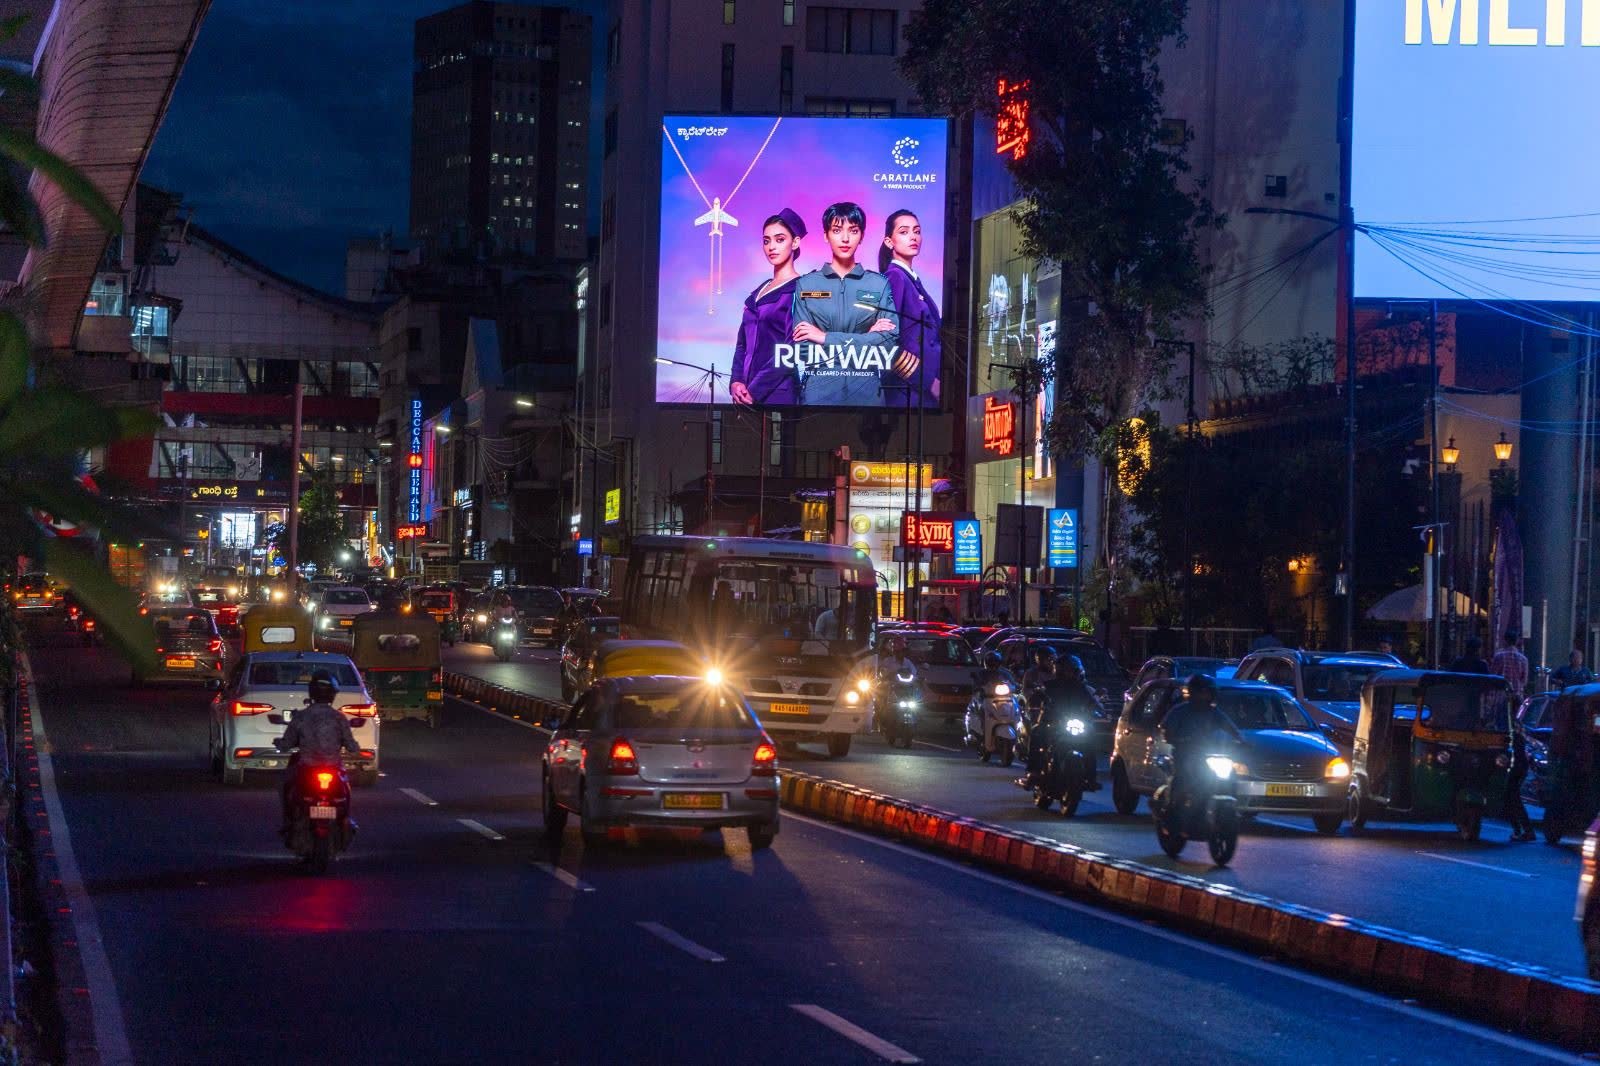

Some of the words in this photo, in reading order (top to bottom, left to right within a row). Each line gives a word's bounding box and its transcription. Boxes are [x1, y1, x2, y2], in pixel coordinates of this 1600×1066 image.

[873, 173, 937, 182] CARATLANE
[775, 342, 899, 370] RUNWAY
[412, 400, 422, 454] DECCAN
[411, 469, 420, 522] HERALD
